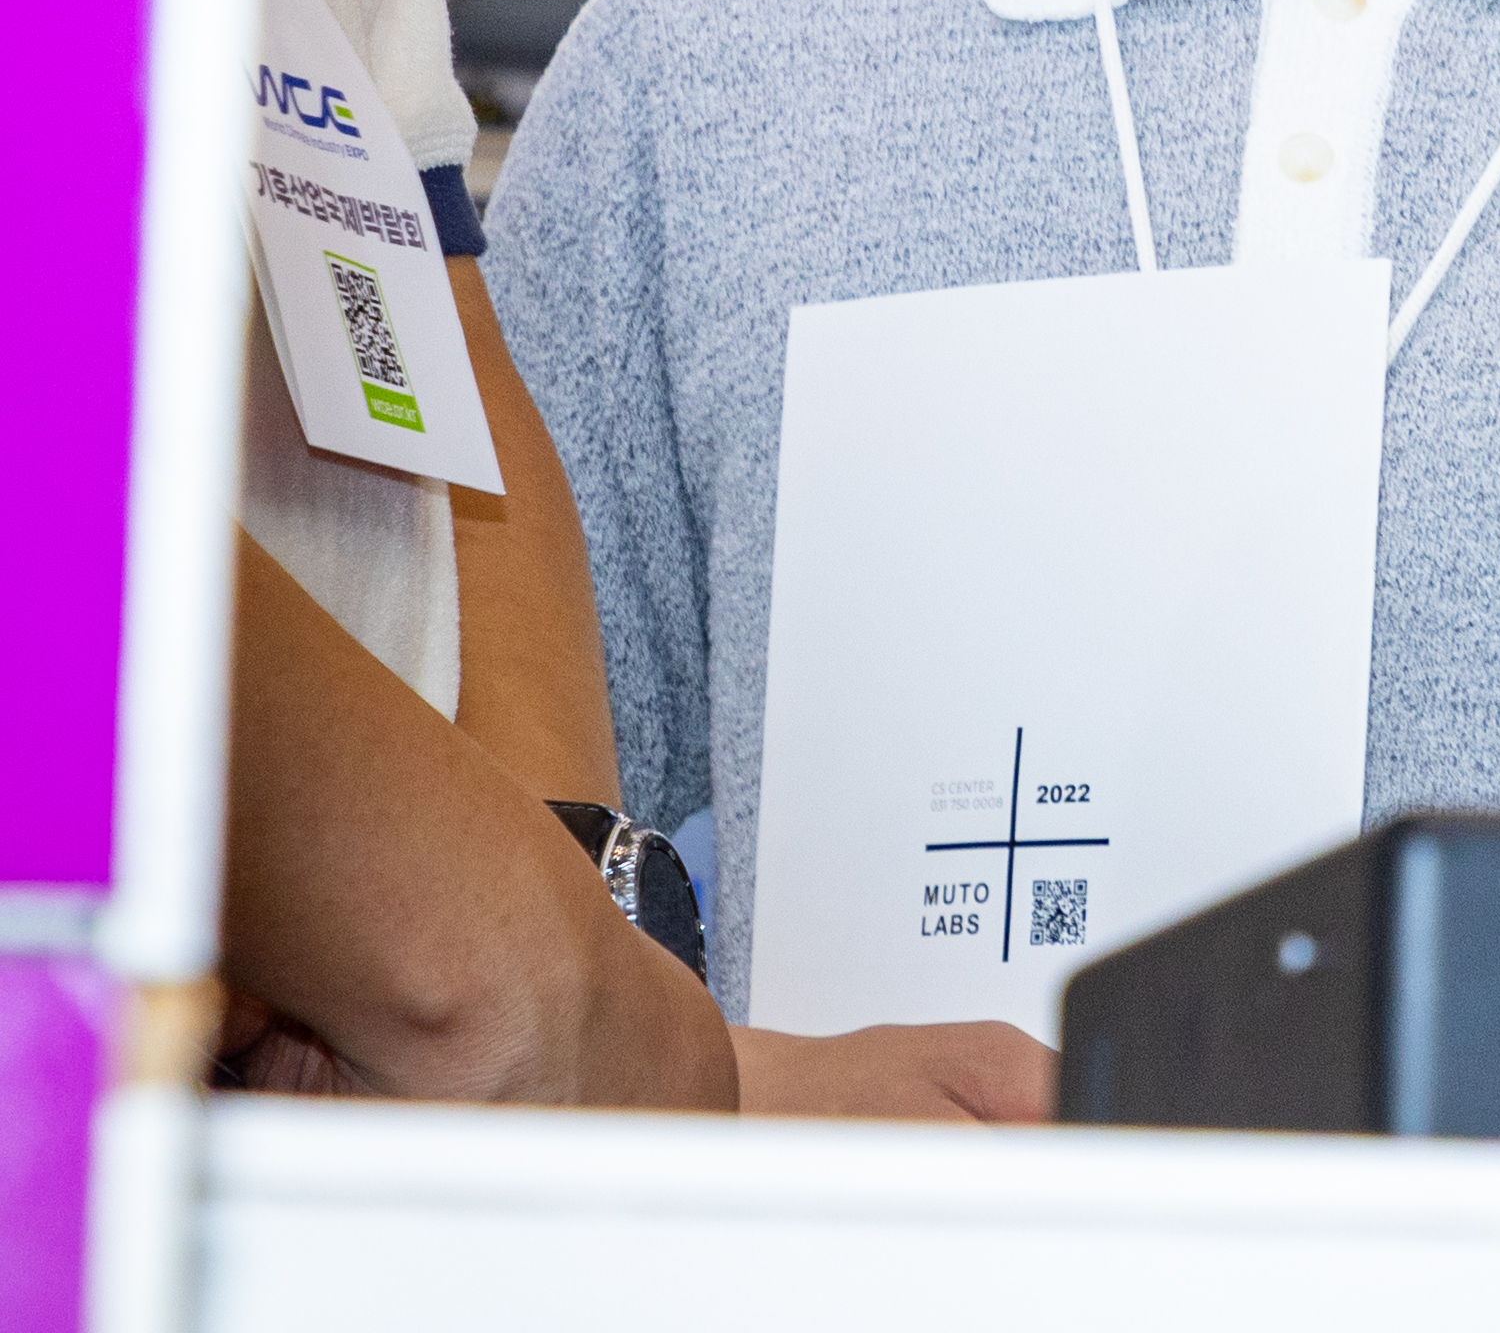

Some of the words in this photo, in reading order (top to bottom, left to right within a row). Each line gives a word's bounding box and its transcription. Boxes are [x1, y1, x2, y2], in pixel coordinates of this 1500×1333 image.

[344, 144, 369, 161] EXPO
[249, 160, 427, 252] 기후산업국제박람회
[949, 781, 995, 795] CENTER
[1036, 784, 1091, 804] 2022
[924, 883, 990, 907] MUTO
[921, 914, 980, 937] LABS
